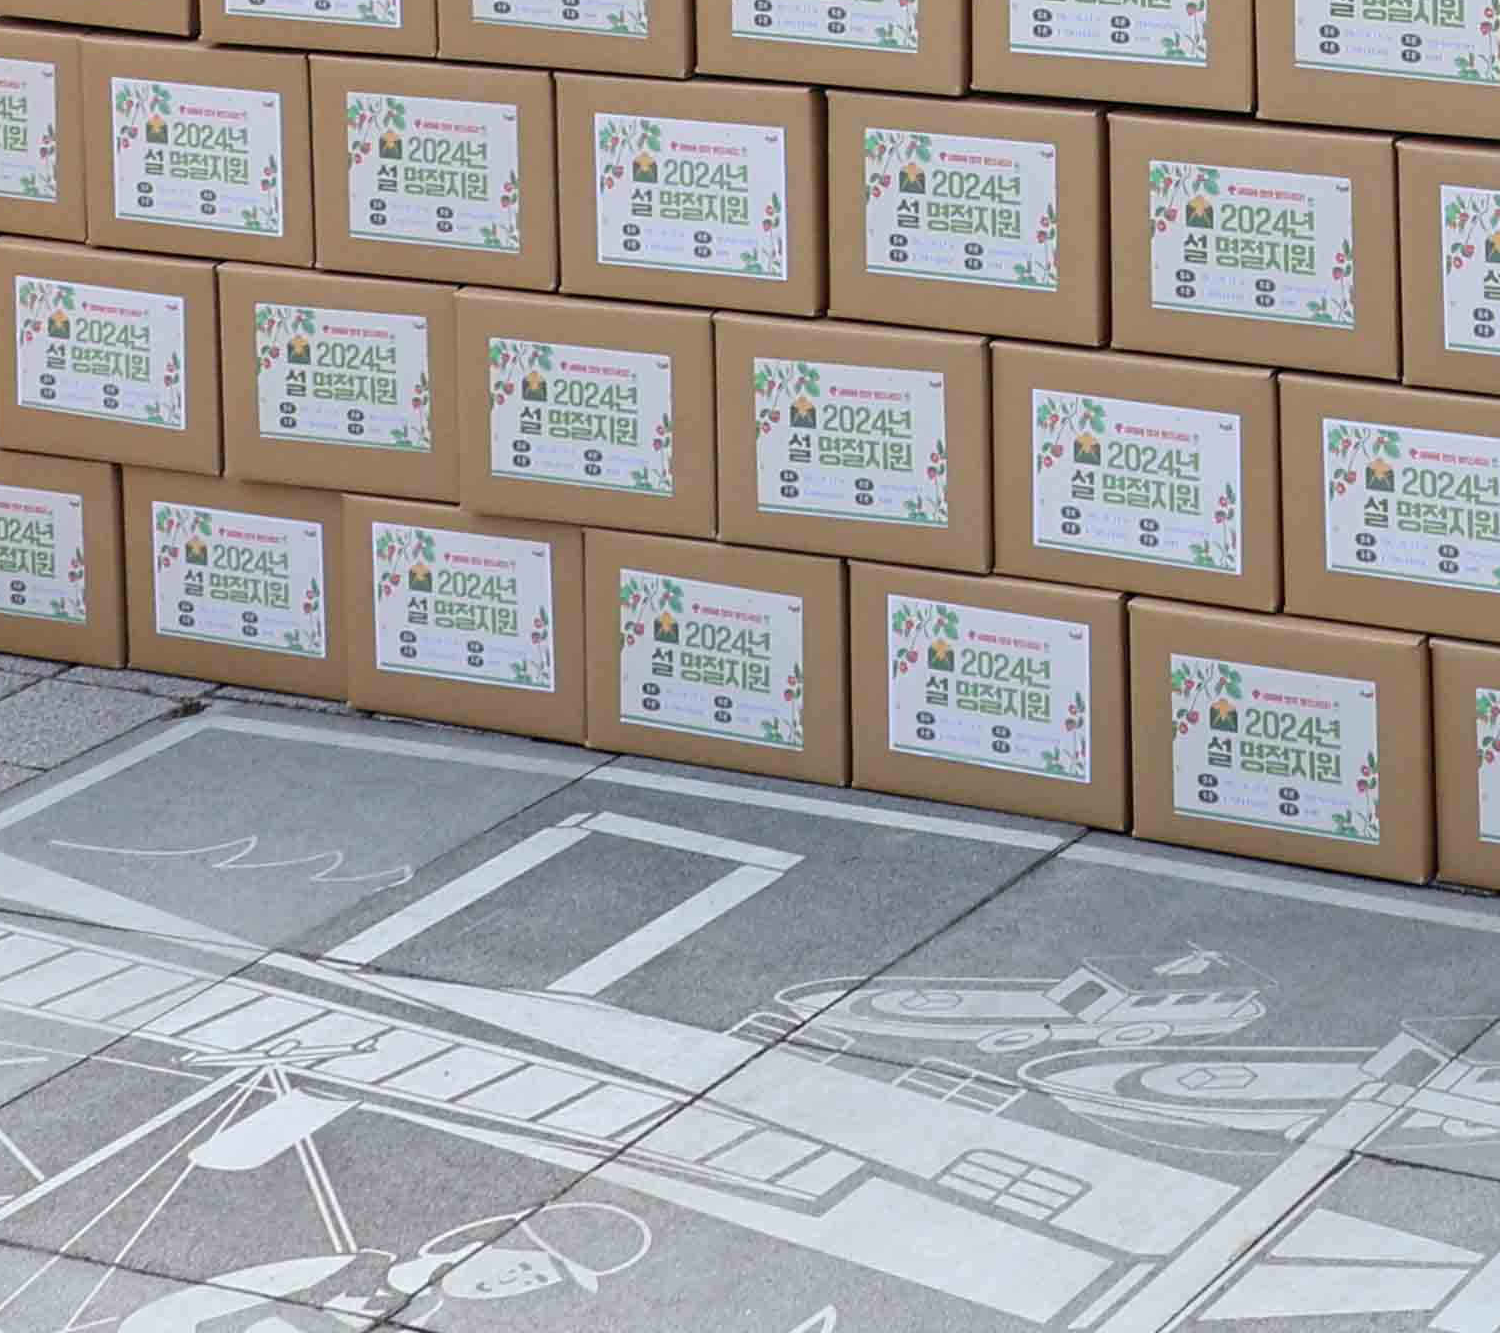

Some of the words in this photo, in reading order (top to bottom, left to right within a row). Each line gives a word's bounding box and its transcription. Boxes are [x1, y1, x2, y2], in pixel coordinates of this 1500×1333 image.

[173, 121, 248, 154] 2024년
[144, 148, 163, 176] 설
[169, 151, 248, 185] 명절지원
[663, 158, 748, 192] 2024년
[630, 187, 652, 217] 설
[659, 190, 748, 225] 명절지원
[75, 317, 150, 351] 2024년
[46, 342, 66, 369] 설
[71, 345, 150, 381] 명절지원
[822, 403, 911, 439] 2024년
[788, 433, 811, 463] 설
[817, 436, 912, 472] 명절지원
[1107, 441, 1199, 481] 2024년
[1070, 469, 1094, 501] 설
[1102, 473, 1199, 516] 명절지원
[1401, 467, 1499, 506] 2024년
[1364, 496, 1389, 527] 설
[1396, 499, 1500, 541] 명절지원
[213, 543, 289, 578] 2024년
[184, 568, 204, 596] 설
[209, 572, 290, 609] 명절지원
[961, 648, 1050, 689] 2024년
[925, 675, 948, 706] 설
[955, 679, 1050, 723] 명절지원
